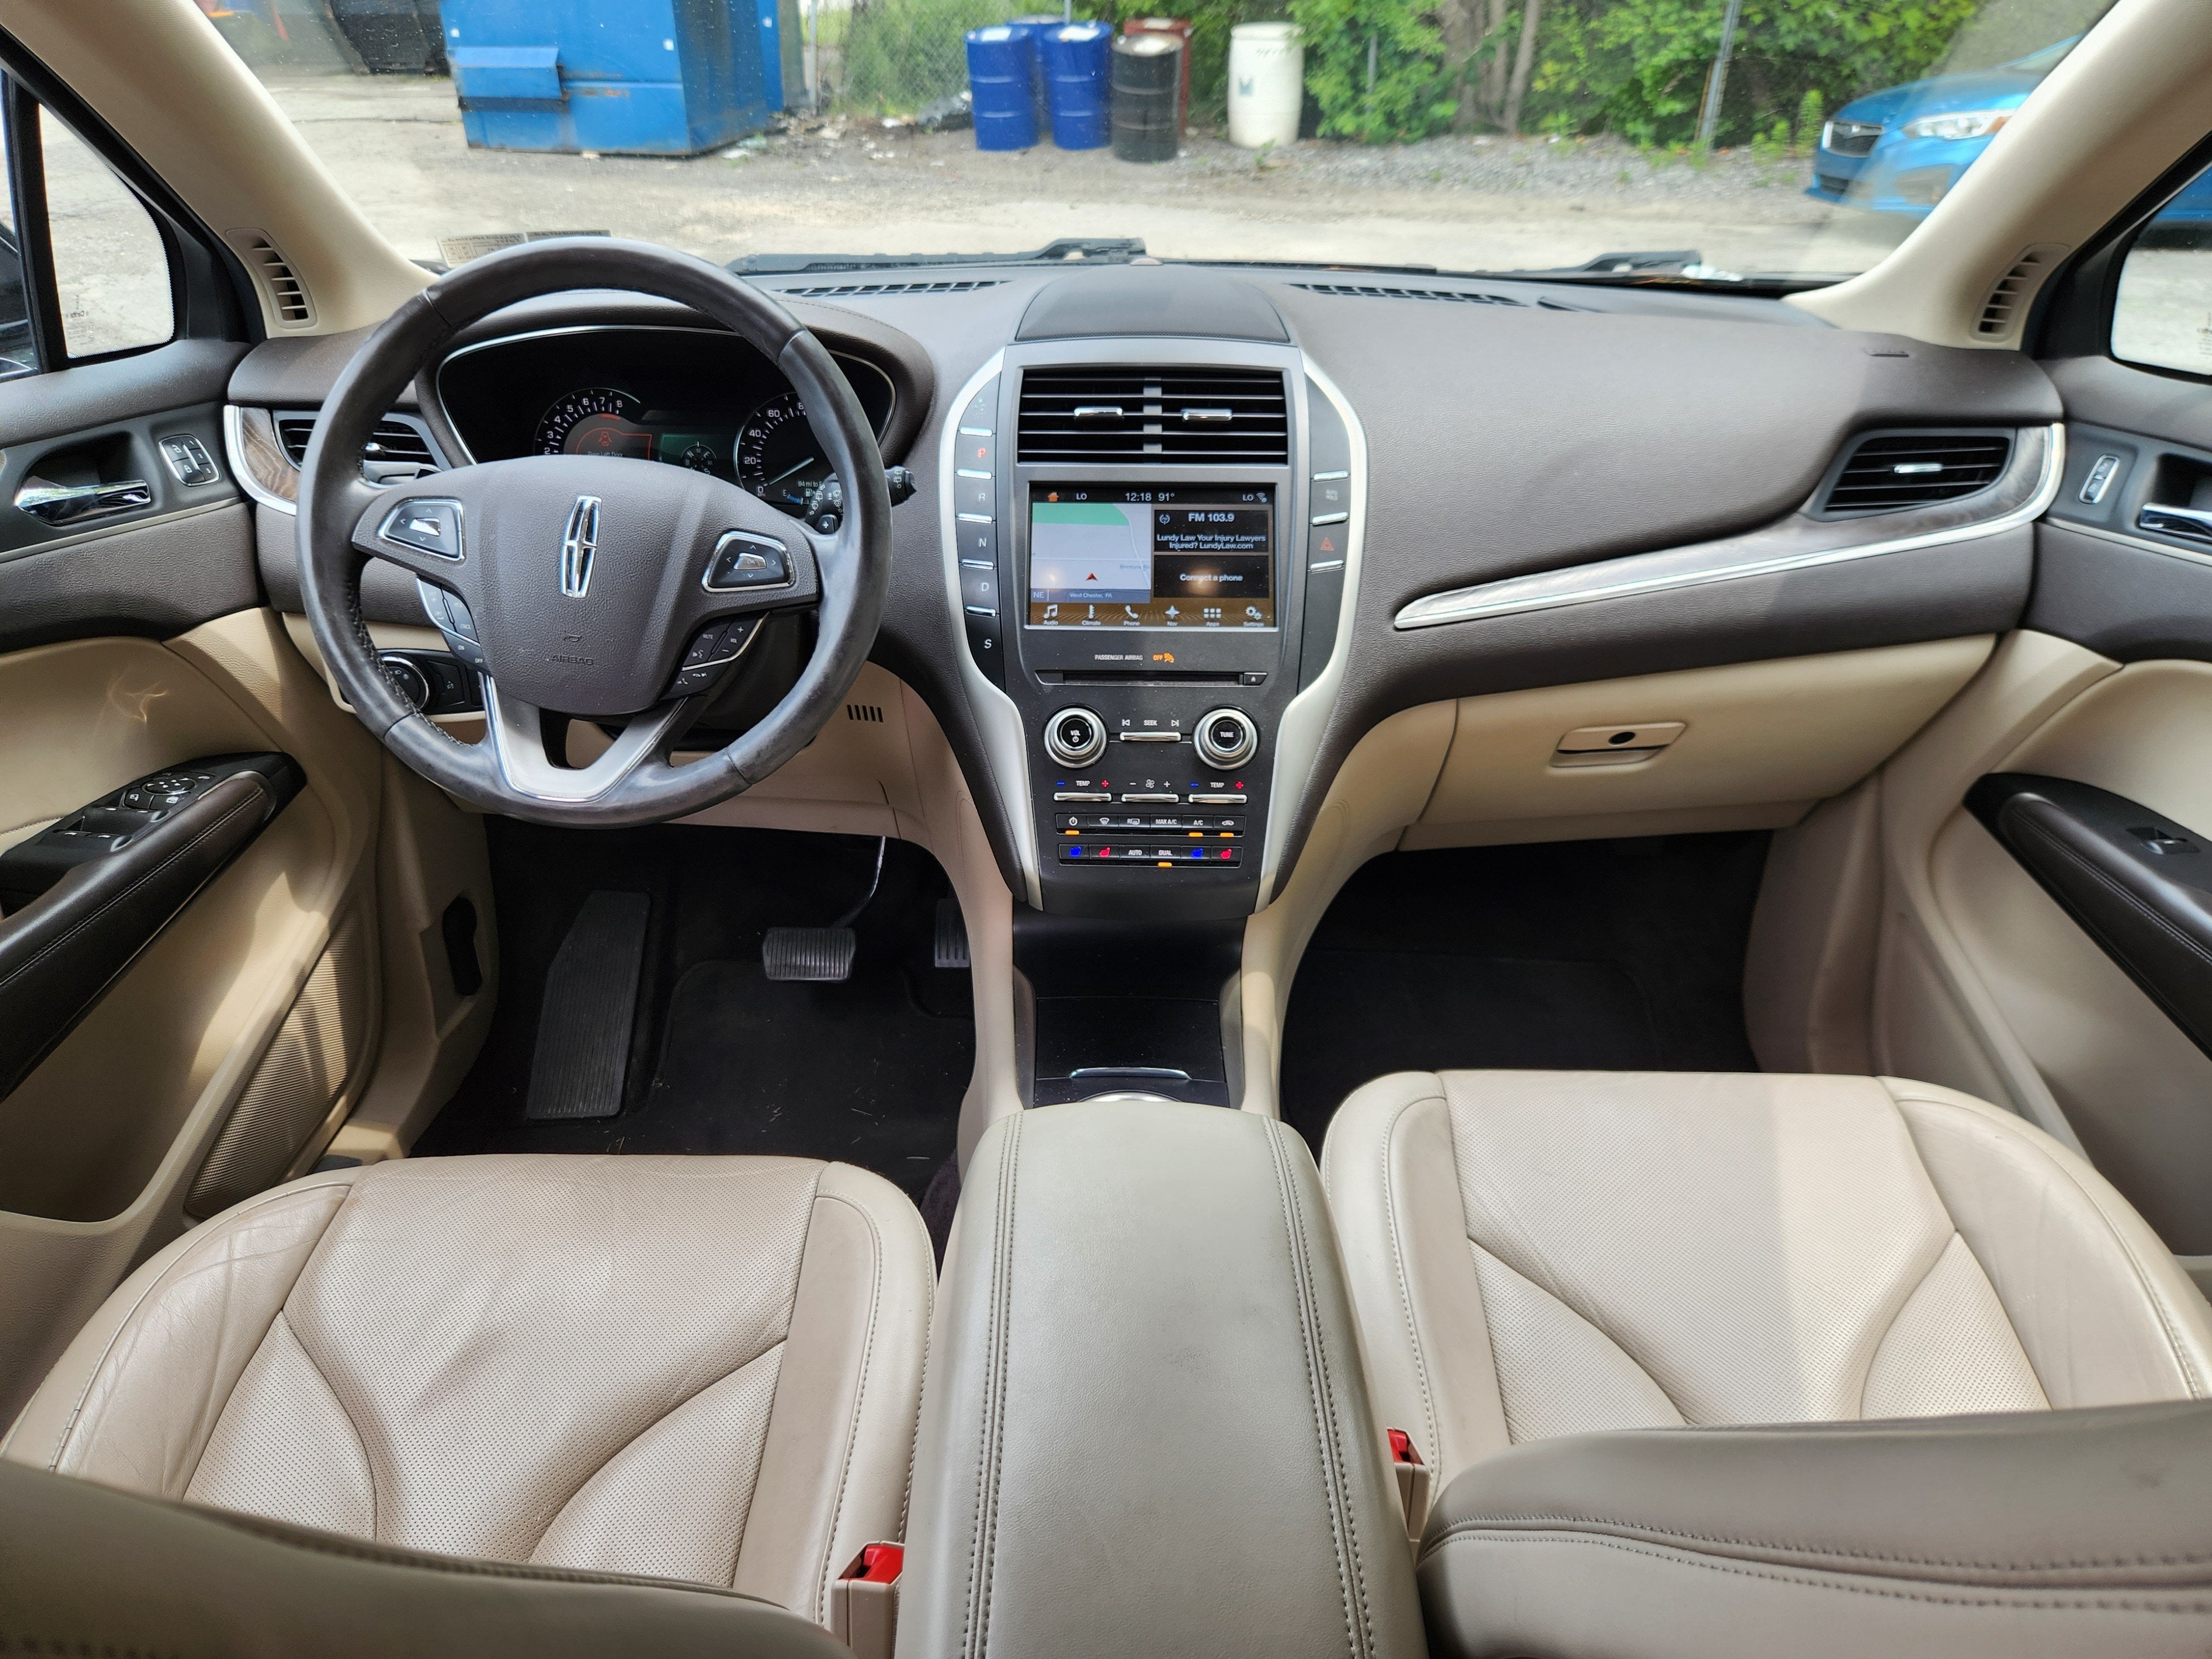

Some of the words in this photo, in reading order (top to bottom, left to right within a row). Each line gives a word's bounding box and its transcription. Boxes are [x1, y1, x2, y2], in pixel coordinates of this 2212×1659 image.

[978, 448, 986, 458] P
[979, 493, 985, 502] R
[1125, 492, 1152, 502] 12:18
[1158, 492, 1175, 502] 91°
[1188, 513, 1205, 522] FM
[1208, 513, 1235, 522] 103.9
[979, 538, 987, 547] N
[1157, 534, 1179, 542] Lundy
[1215, 535, 1235, 543] Injury
[1236, 535, 1266, 543] Lawyers
[1219, 574, 1243, 582] phone
[981, 582, 989, 592] D
[984, 639, 992, 649] S
[552, 654, 594, 665] AIRBAG
